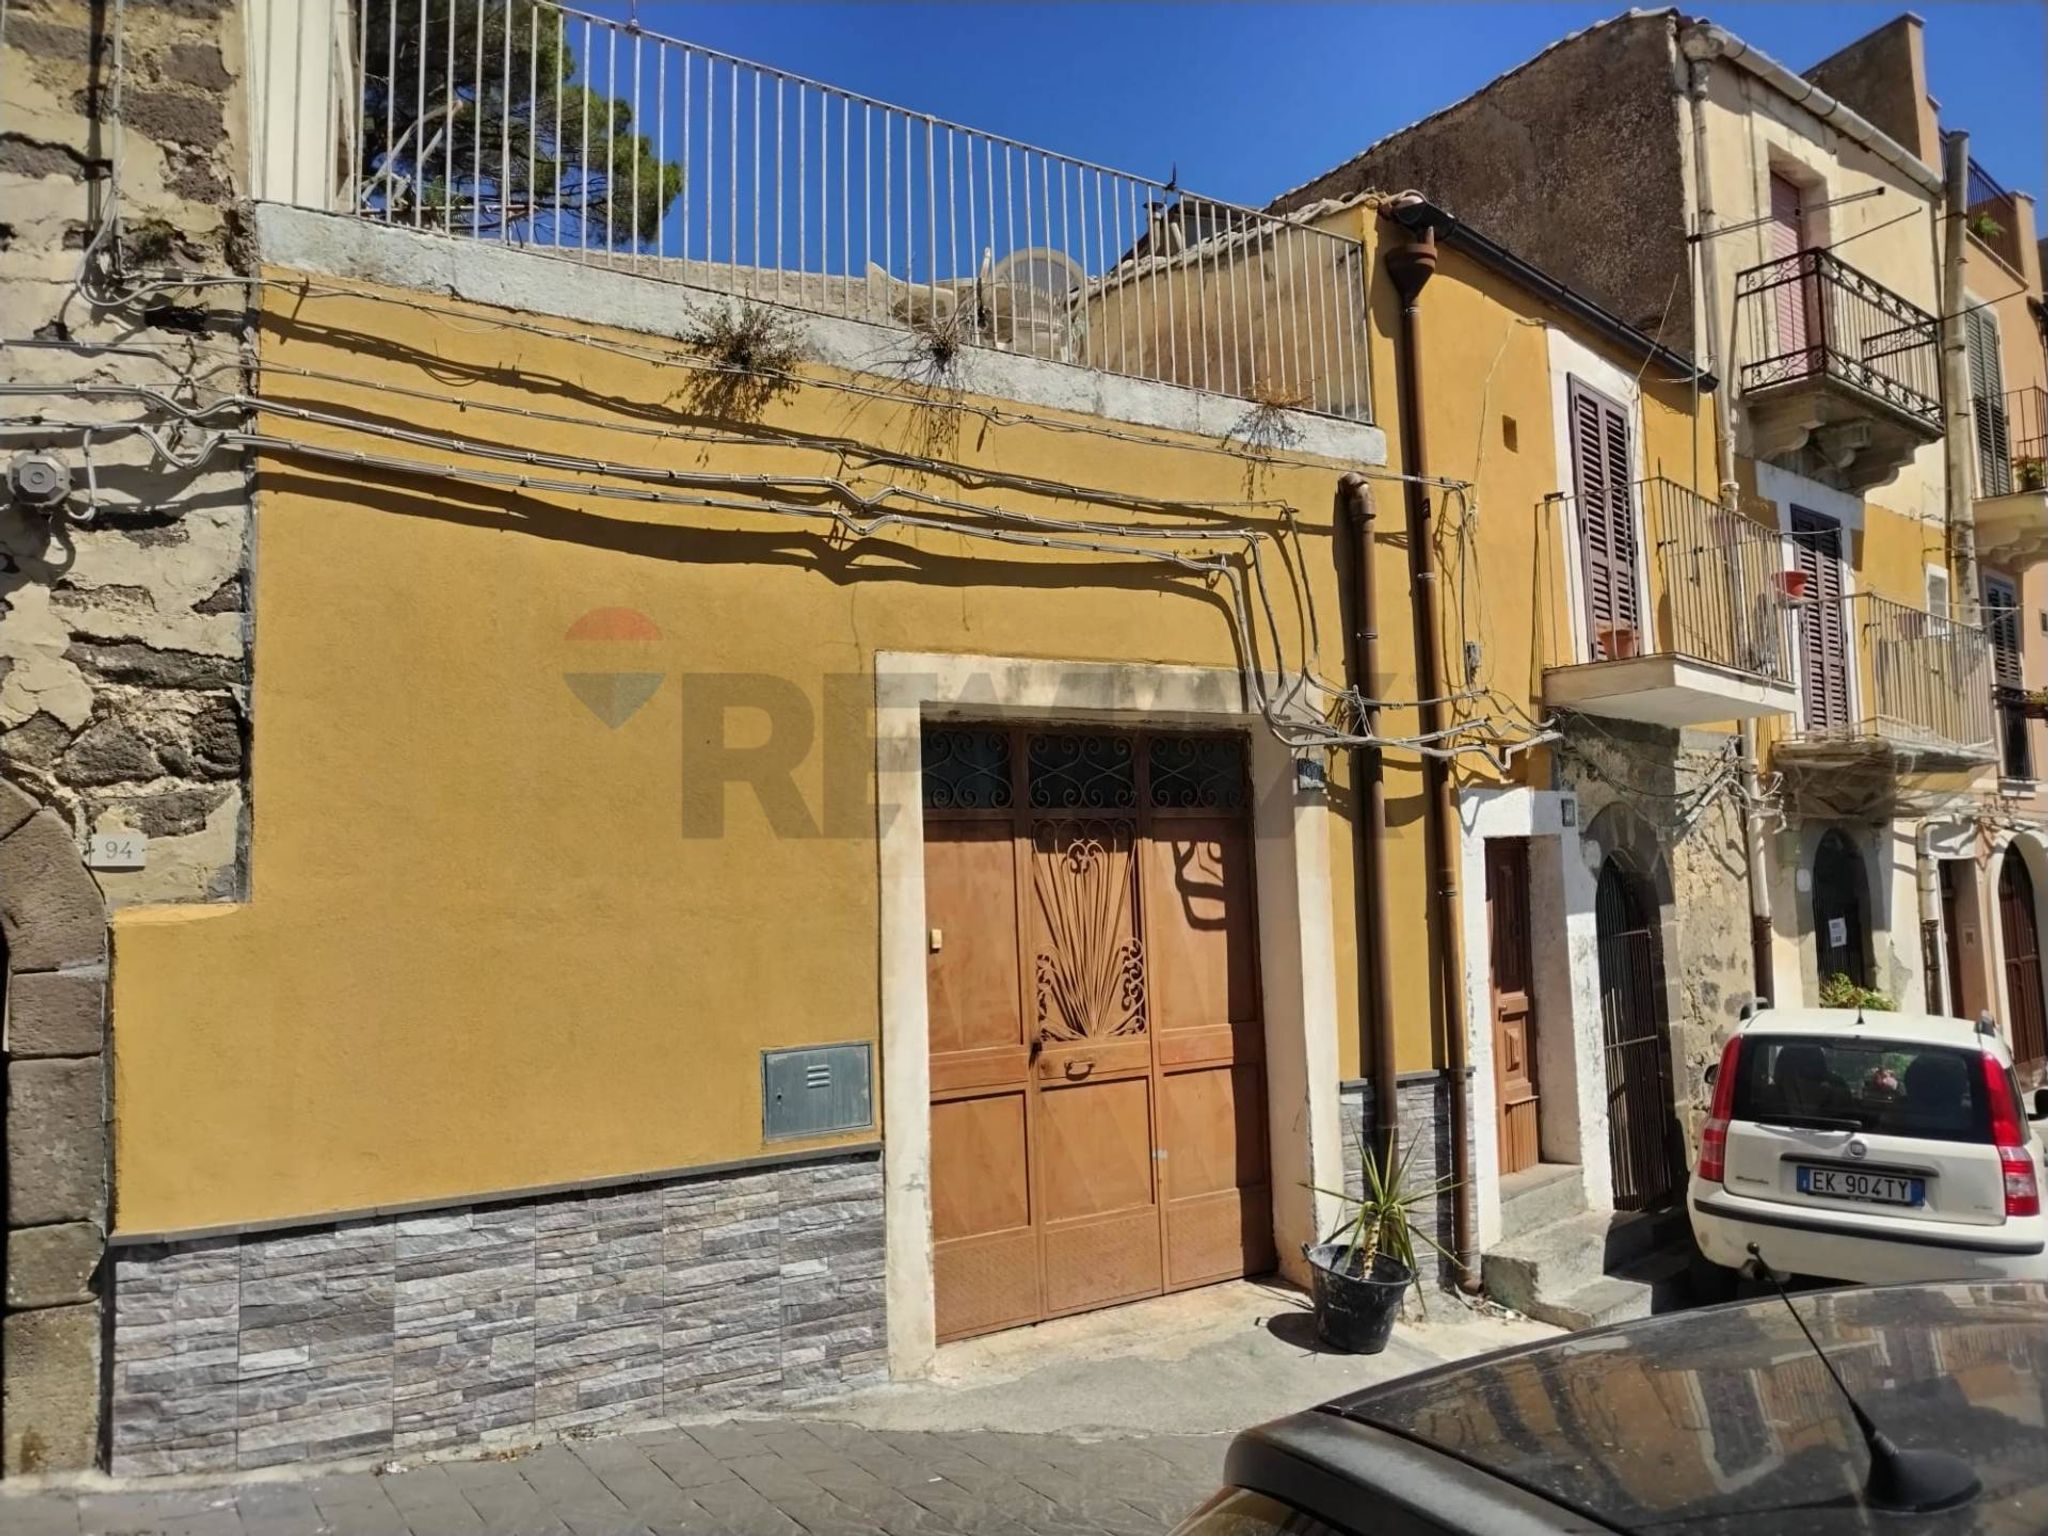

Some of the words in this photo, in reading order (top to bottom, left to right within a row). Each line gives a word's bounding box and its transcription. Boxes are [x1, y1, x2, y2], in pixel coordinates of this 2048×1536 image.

[105, 841, 132, 859] 94
[1813, 1172, 1835, 1192] EK
[1845, 1175, 1908, 1199] 904TY
